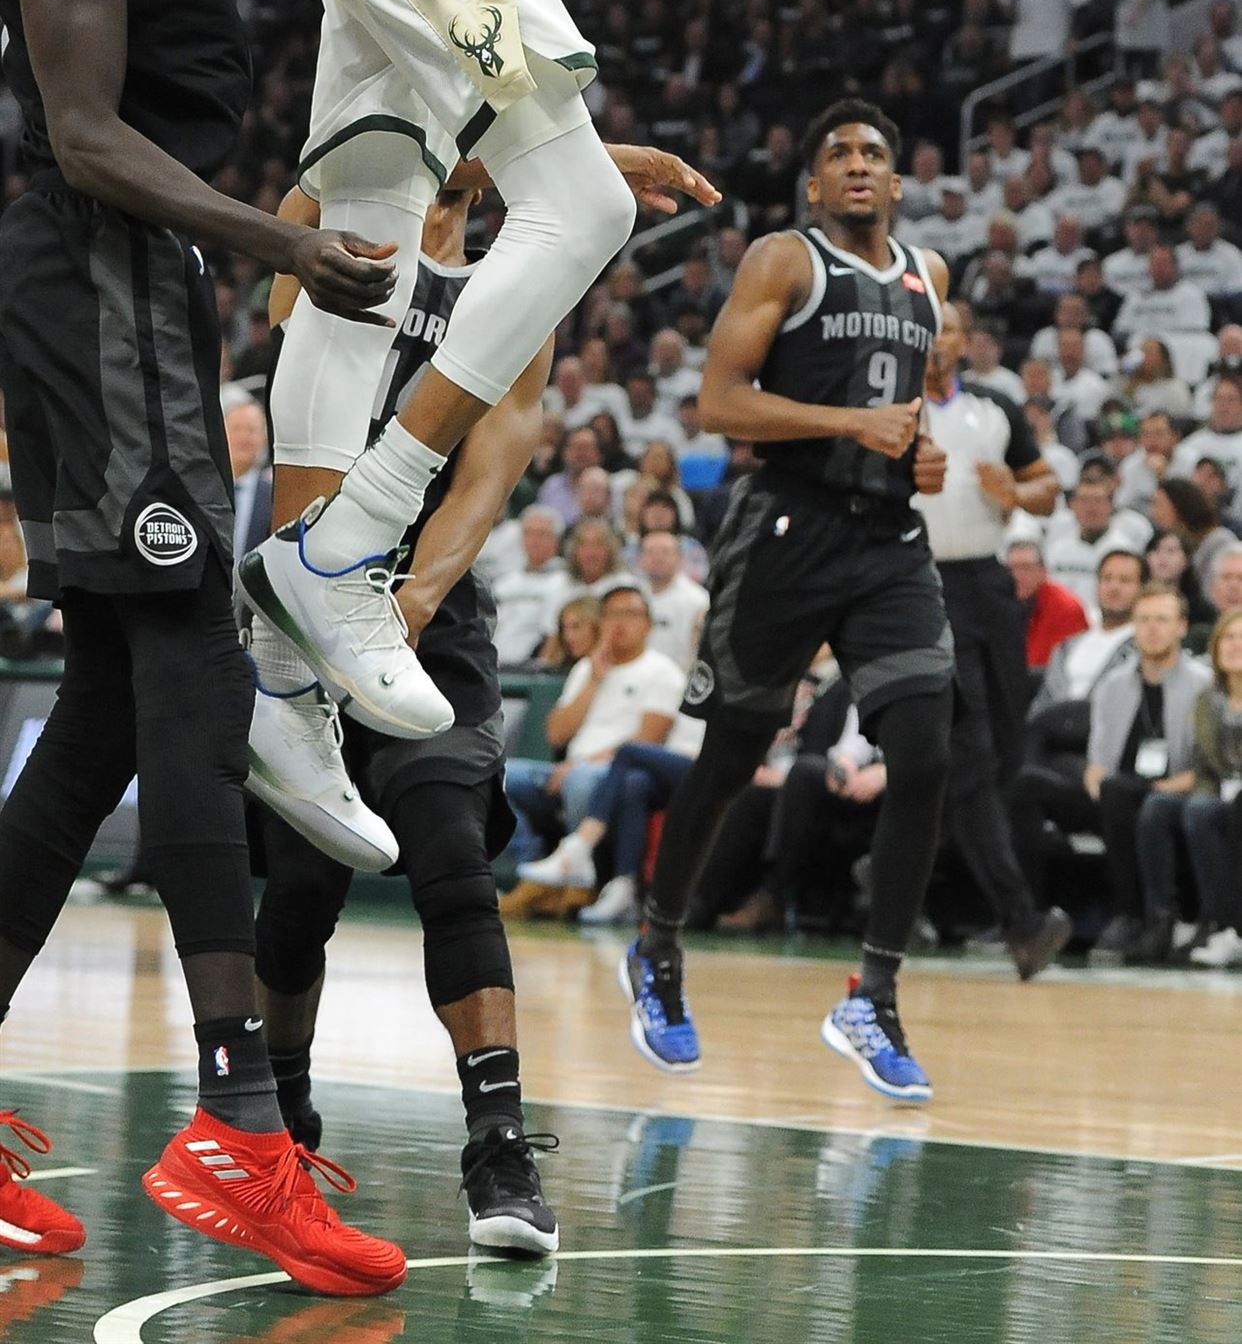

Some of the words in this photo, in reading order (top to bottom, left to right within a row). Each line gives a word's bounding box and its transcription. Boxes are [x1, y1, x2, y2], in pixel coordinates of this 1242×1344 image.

[820, 312, 899, 340] MOTOR
[867, 351, 899, 406] 9
[146, 522, 185, 534] DETROIT
[146, 533, 188, 545] PISTONS
